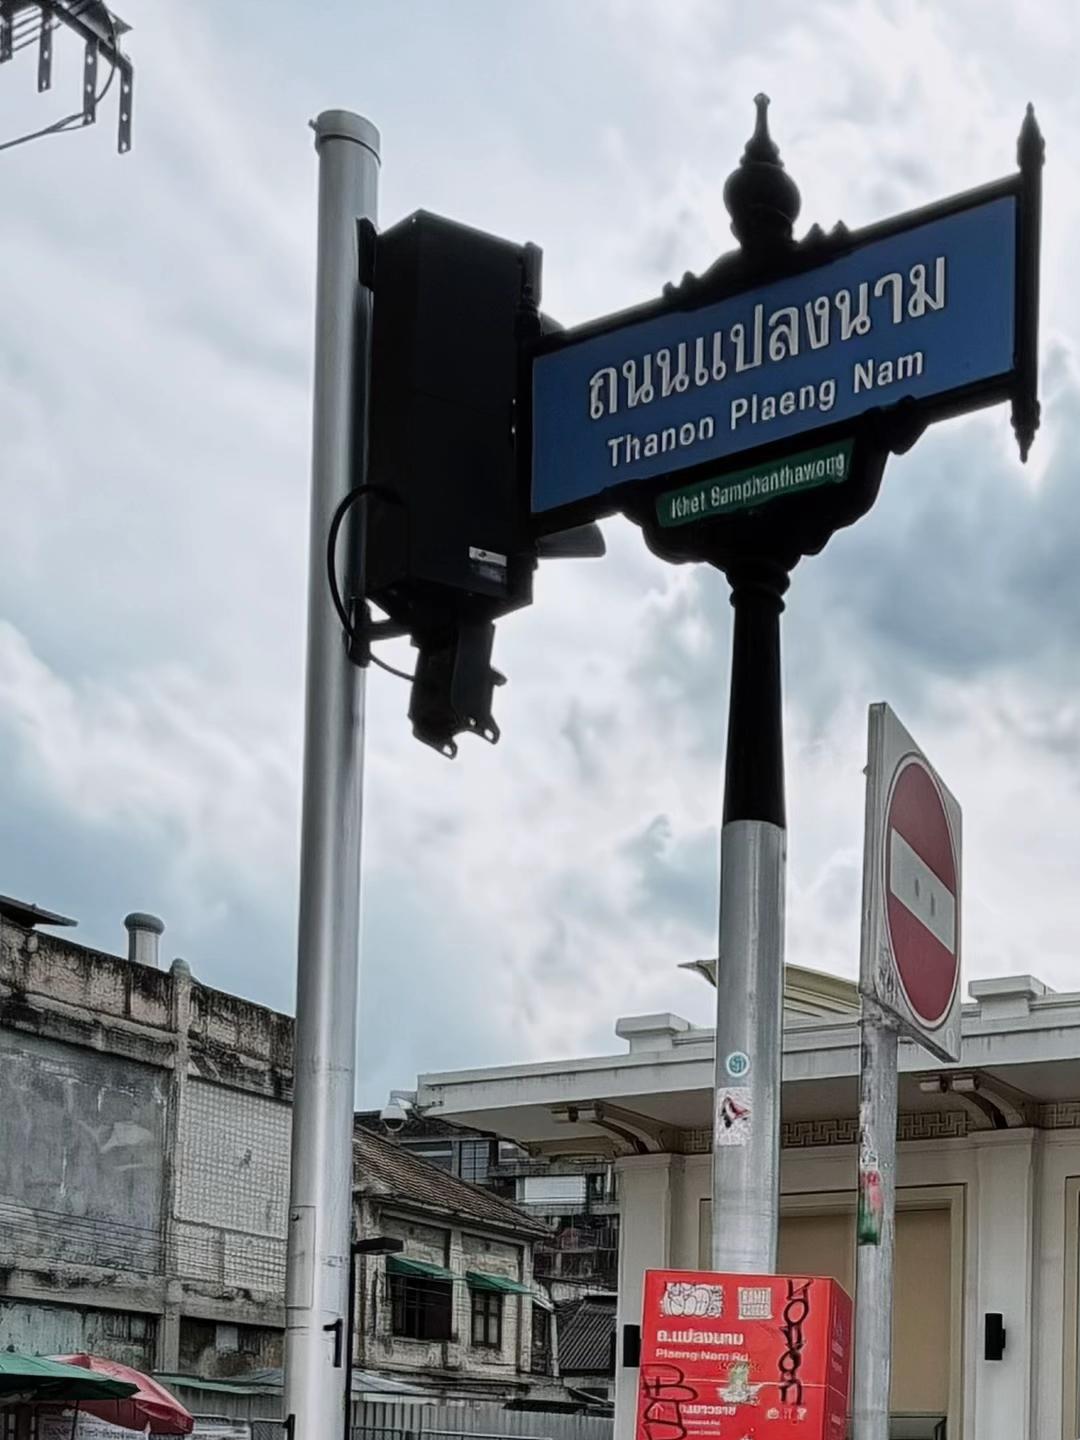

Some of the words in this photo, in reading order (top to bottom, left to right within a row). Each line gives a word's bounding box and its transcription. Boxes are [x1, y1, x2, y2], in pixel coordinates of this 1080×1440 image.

[588, 257, 946, 420] ถนนแปลงนาม
[607, 416, 714, 467] Thanon
[730, 378, 836, 430] Plaeng
[853, 351, 924, 394] Nam
[671, 491, 705, 519] Khet
[655, 1348, 697, 1362] Plaeng
